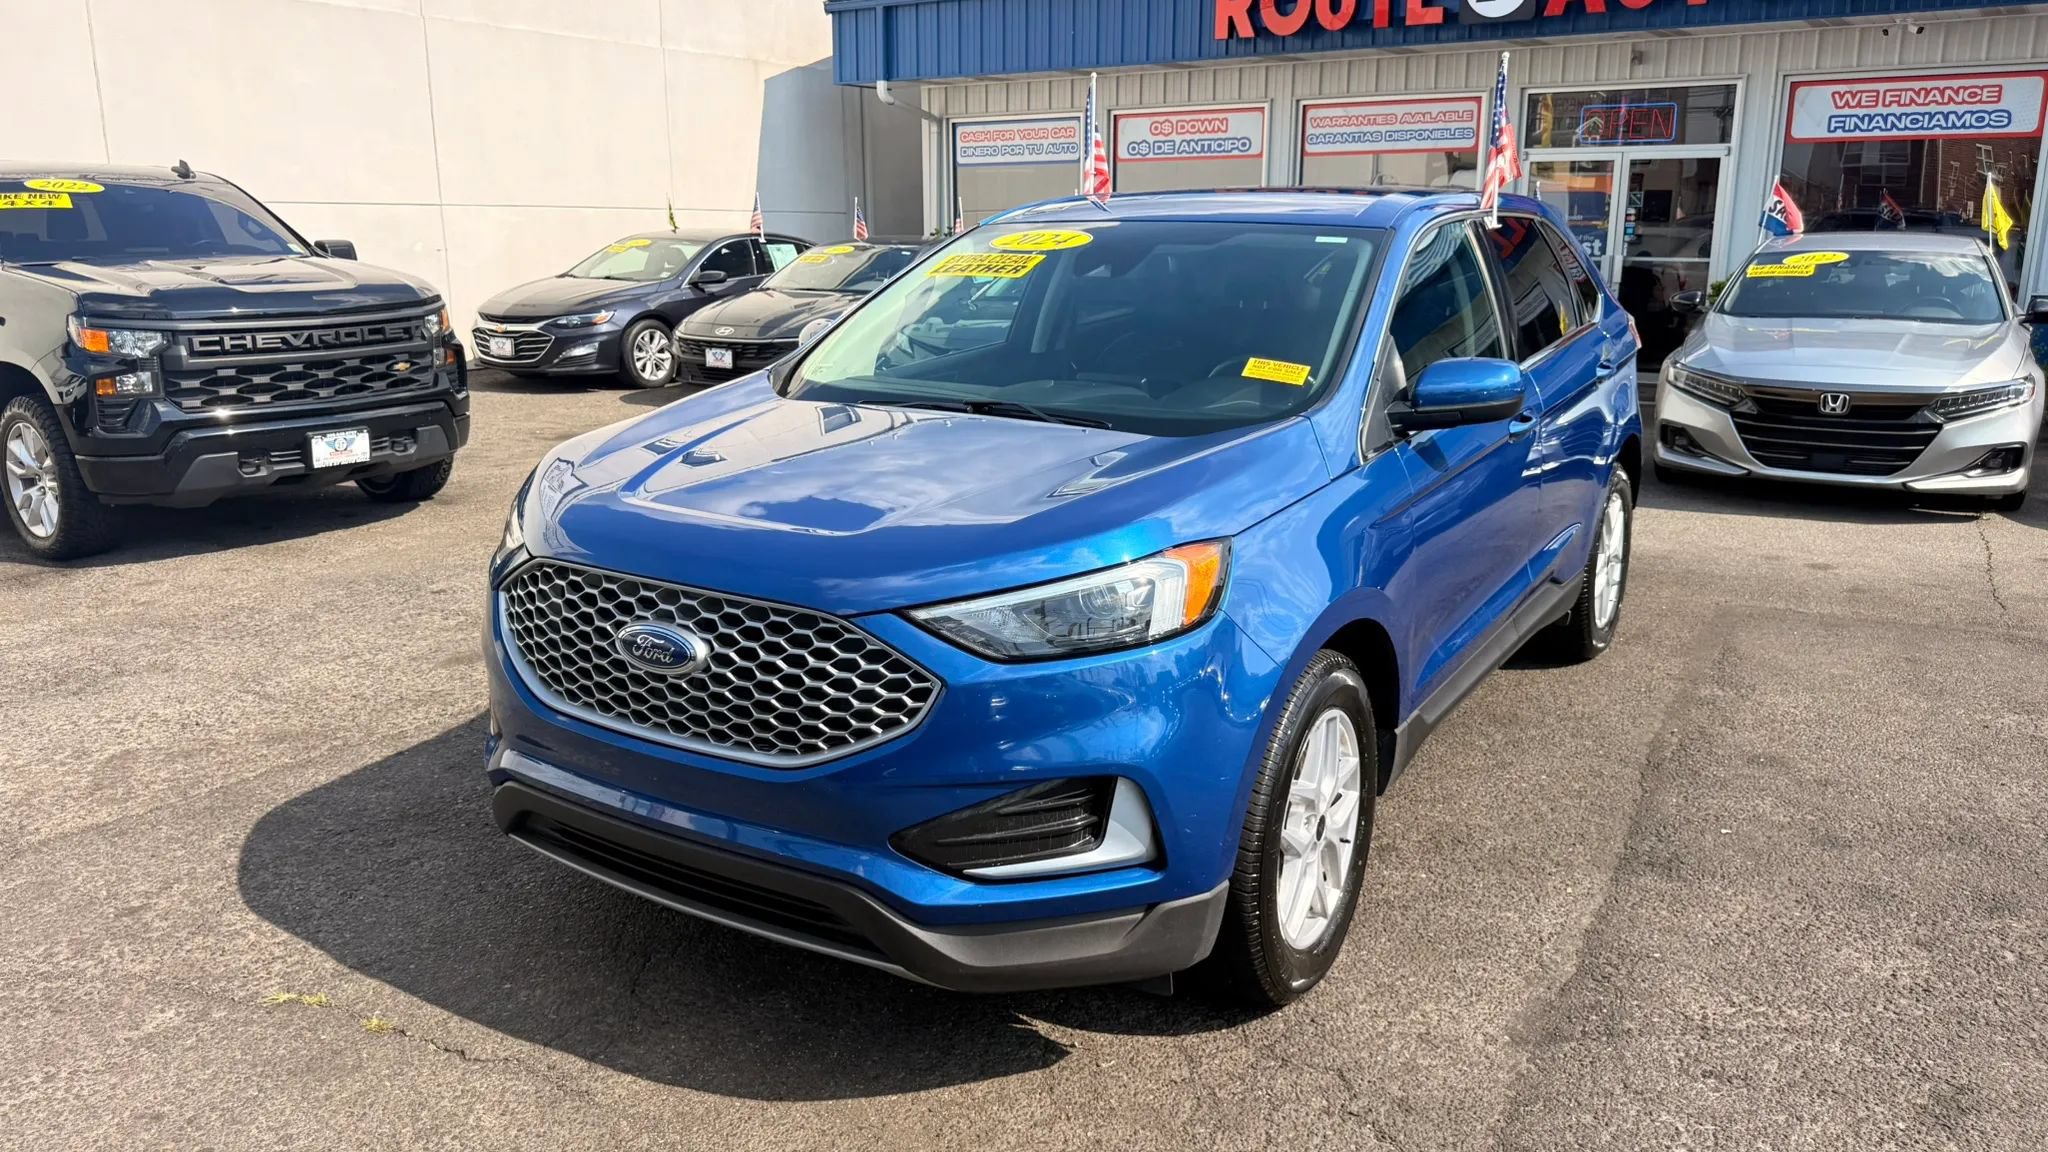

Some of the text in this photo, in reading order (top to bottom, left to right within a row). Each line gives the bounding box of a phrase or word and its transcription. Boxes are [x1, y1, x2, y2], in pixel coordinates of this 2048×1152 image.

[1832, 85, 2002, 110] WE FINANCE
[1176, 117, 1229, 135] DOWN
[1310, 110, 1474, 128] WARRANTIES AVAILABLE
[1584, 108, 1674, 139] OPEN
[1828, 109, 2012, 133] FINANCIAMOS
[960, 127, 1076, 143] CASH FOR YOUR CAR
[1307, 127, 1475, 144] GARANTIAS DISPONIBLES
[960, 142, 1079, 158] DINERO POR TU AUTO
[1153, 139, 1176, 155] DE
[1177, 137, 1252, 154] ANTICIPO
[39, 180, 90, 190] 2022
[0, 193, 22, 201] IKE
[1000, 233, 1082, 246] 2024
[944, 255, 1036, 265] EXTRA CLEAN
[935, 264, 1028, 274] LEATHER
[191, 321, 425, 352] CHEVROLET
[1273, 362, 1306, 372] VEHICLE
[632, 634, 676, 664] Ford
